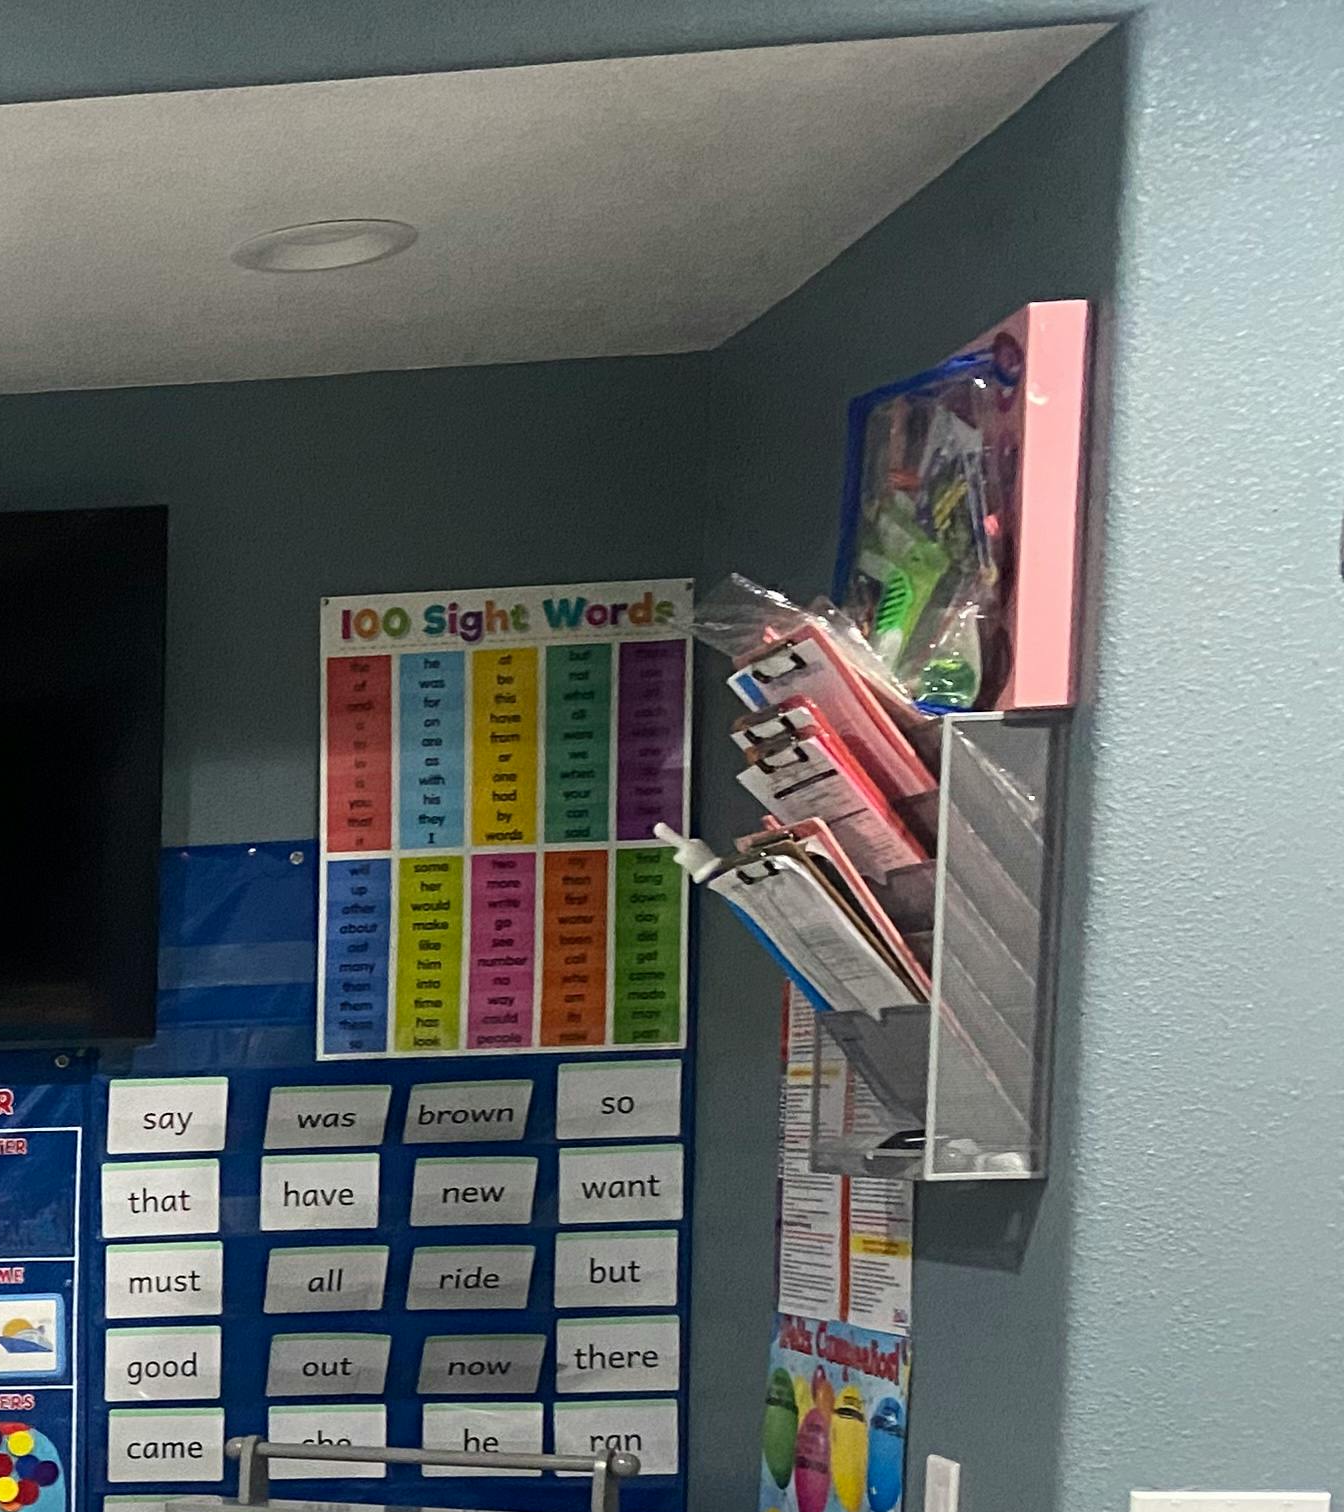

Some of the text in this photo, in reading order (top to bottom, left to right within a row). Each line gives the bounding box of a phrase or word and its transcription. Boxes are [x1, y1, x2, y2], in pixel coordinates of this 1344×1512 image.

[341, 593, 676, 644] 100 Sight Words
[143, 1094, 635, 1135] say was brown so
[128, 1175, 660, 1212] that have new want
[128, 1260, 641, 1294] must all ride but
[126, 1346, 658, 1385] good out now there
[126, 1428, 642, 1460] came he ran
